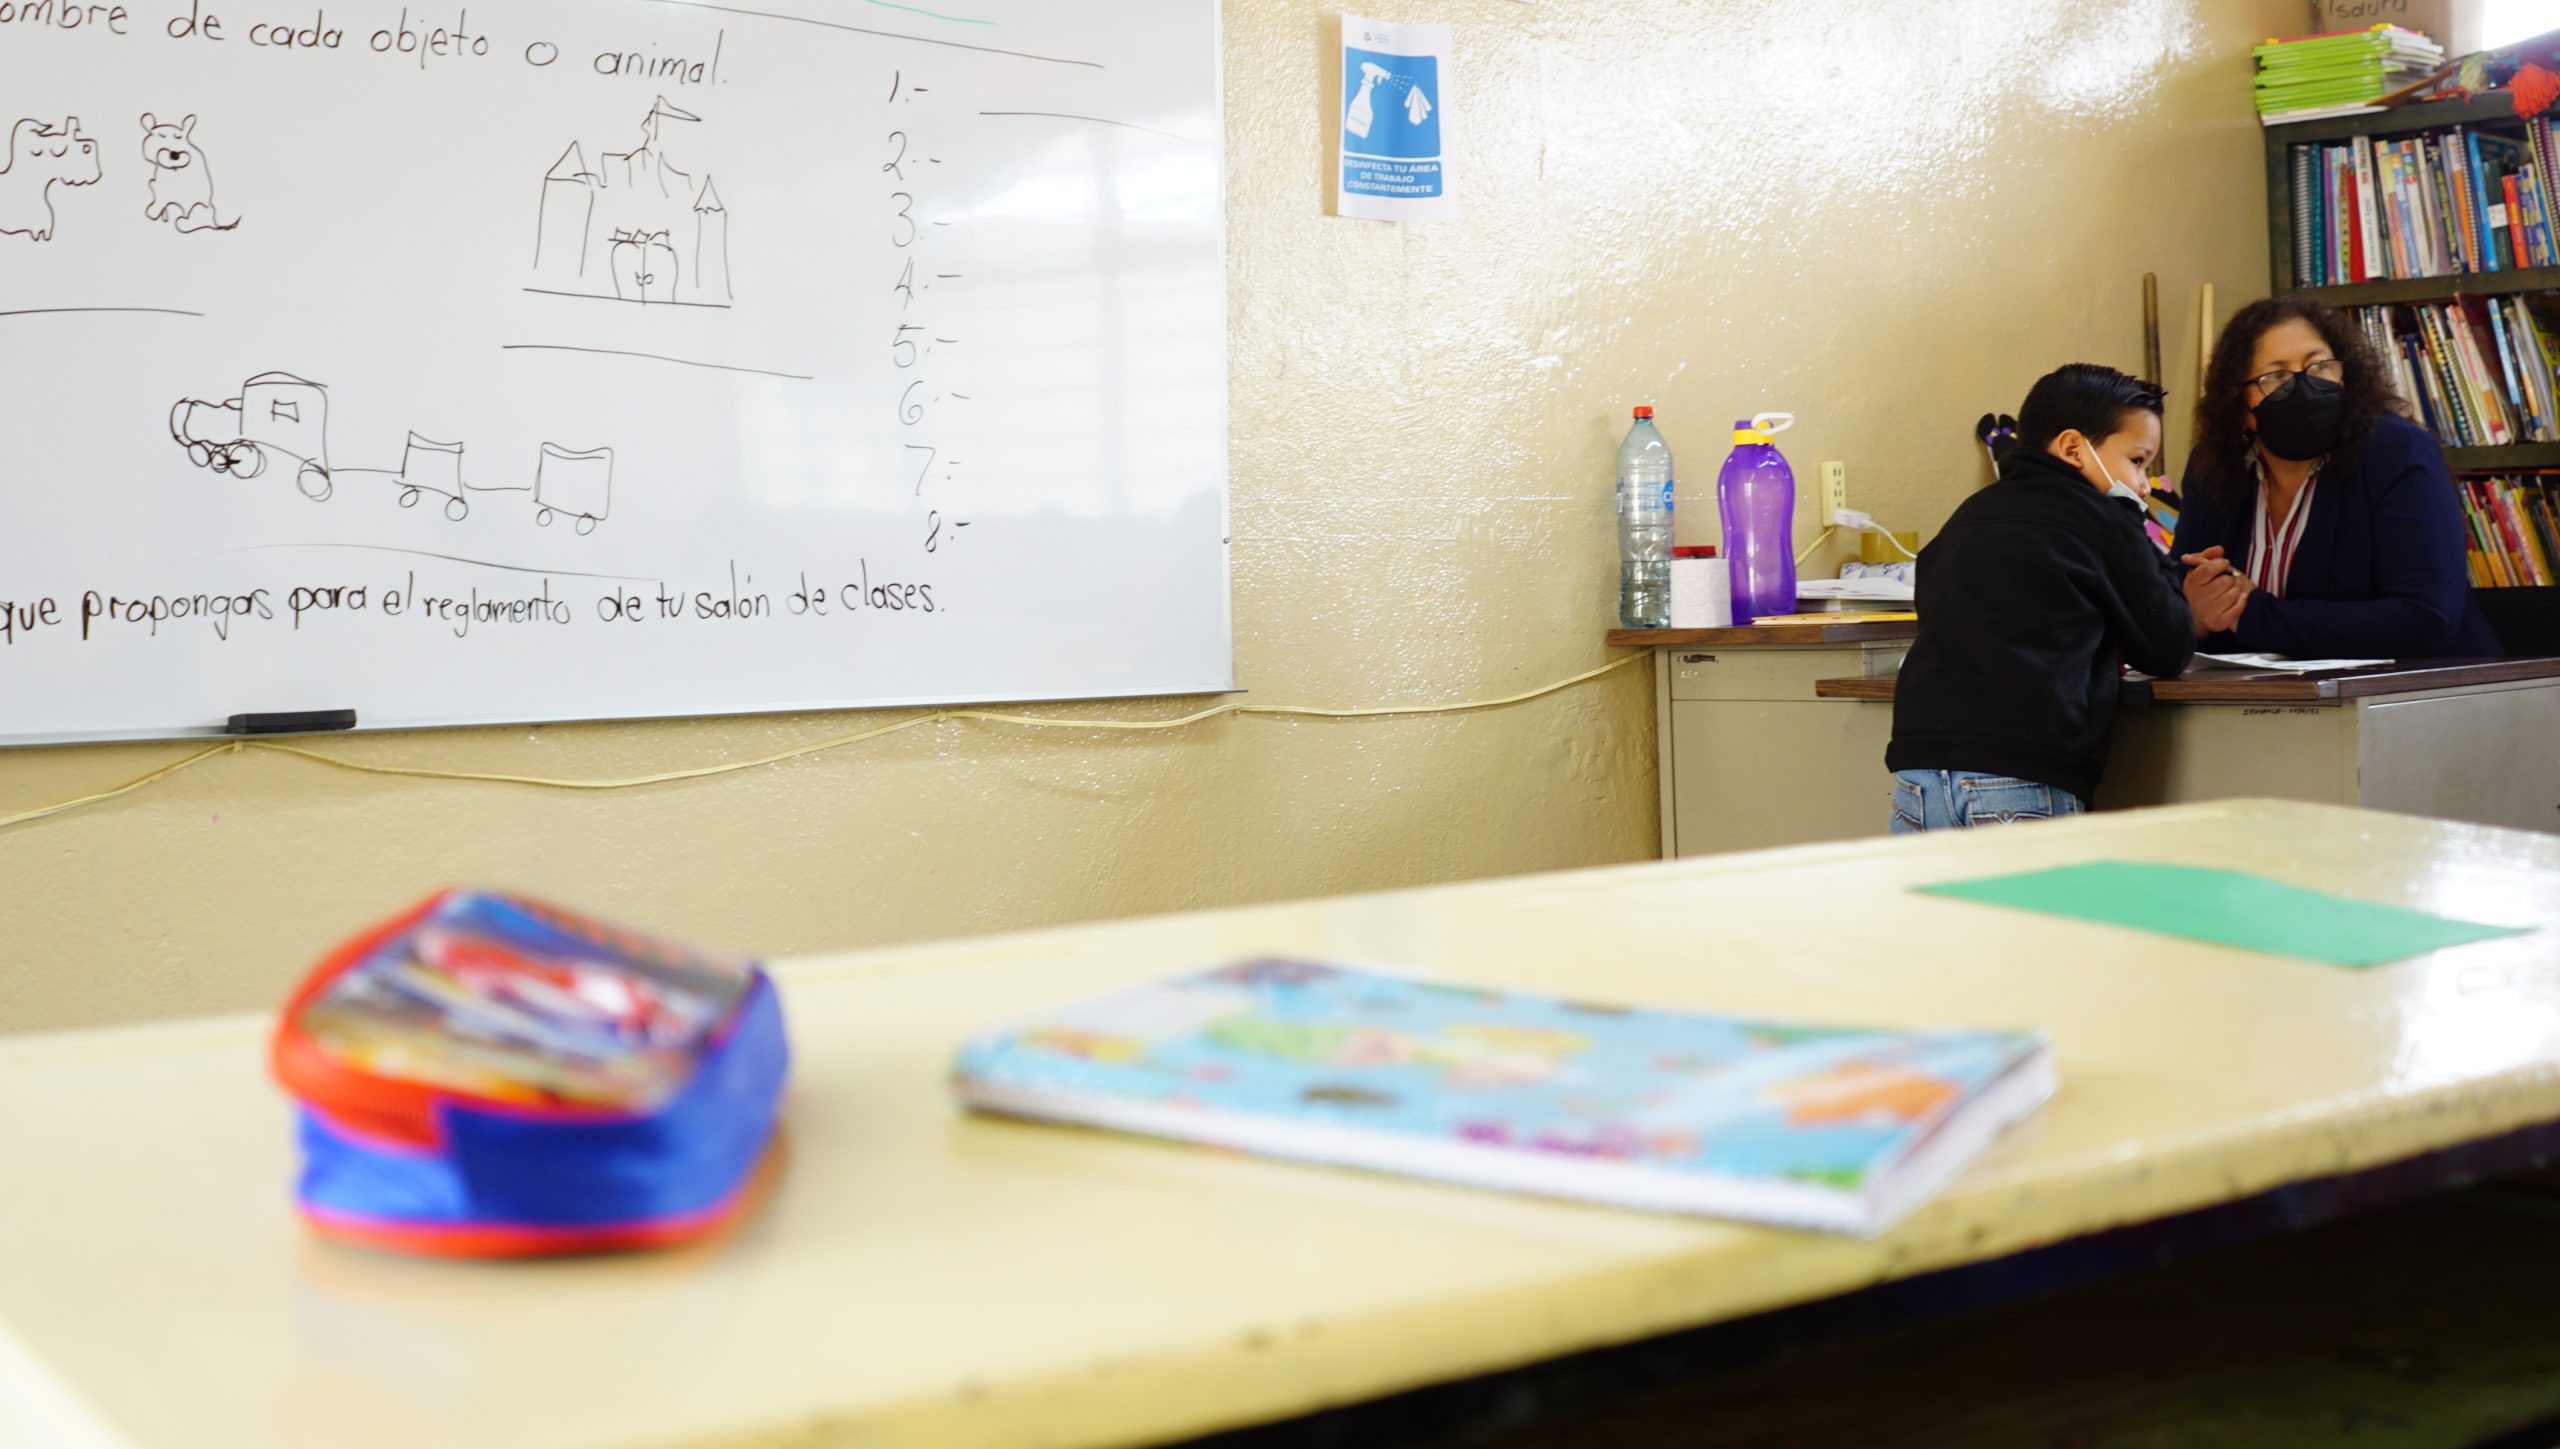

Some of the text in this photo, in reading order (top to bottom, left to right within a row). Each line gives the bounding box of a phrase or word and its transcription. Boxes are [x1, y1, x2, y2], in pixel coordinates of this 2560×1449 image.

[167, 0, 225, 41] de
[249, 9, 343, 49] cada
[370, 7, 488, 70] objeto
[525, 42, 558, 66] o
[594, 29, 727, 85] animal.
[1344, 158, 1439, 173] DESINFECTA TU ÁREA
[1360, 171, 1415, 183] DE TRABAJO
[1347, 180, 1433, 193] CONSTANTEMENTE
[0, 557, 945, 645] que propongas para el reglamento de tu salón de clases.
